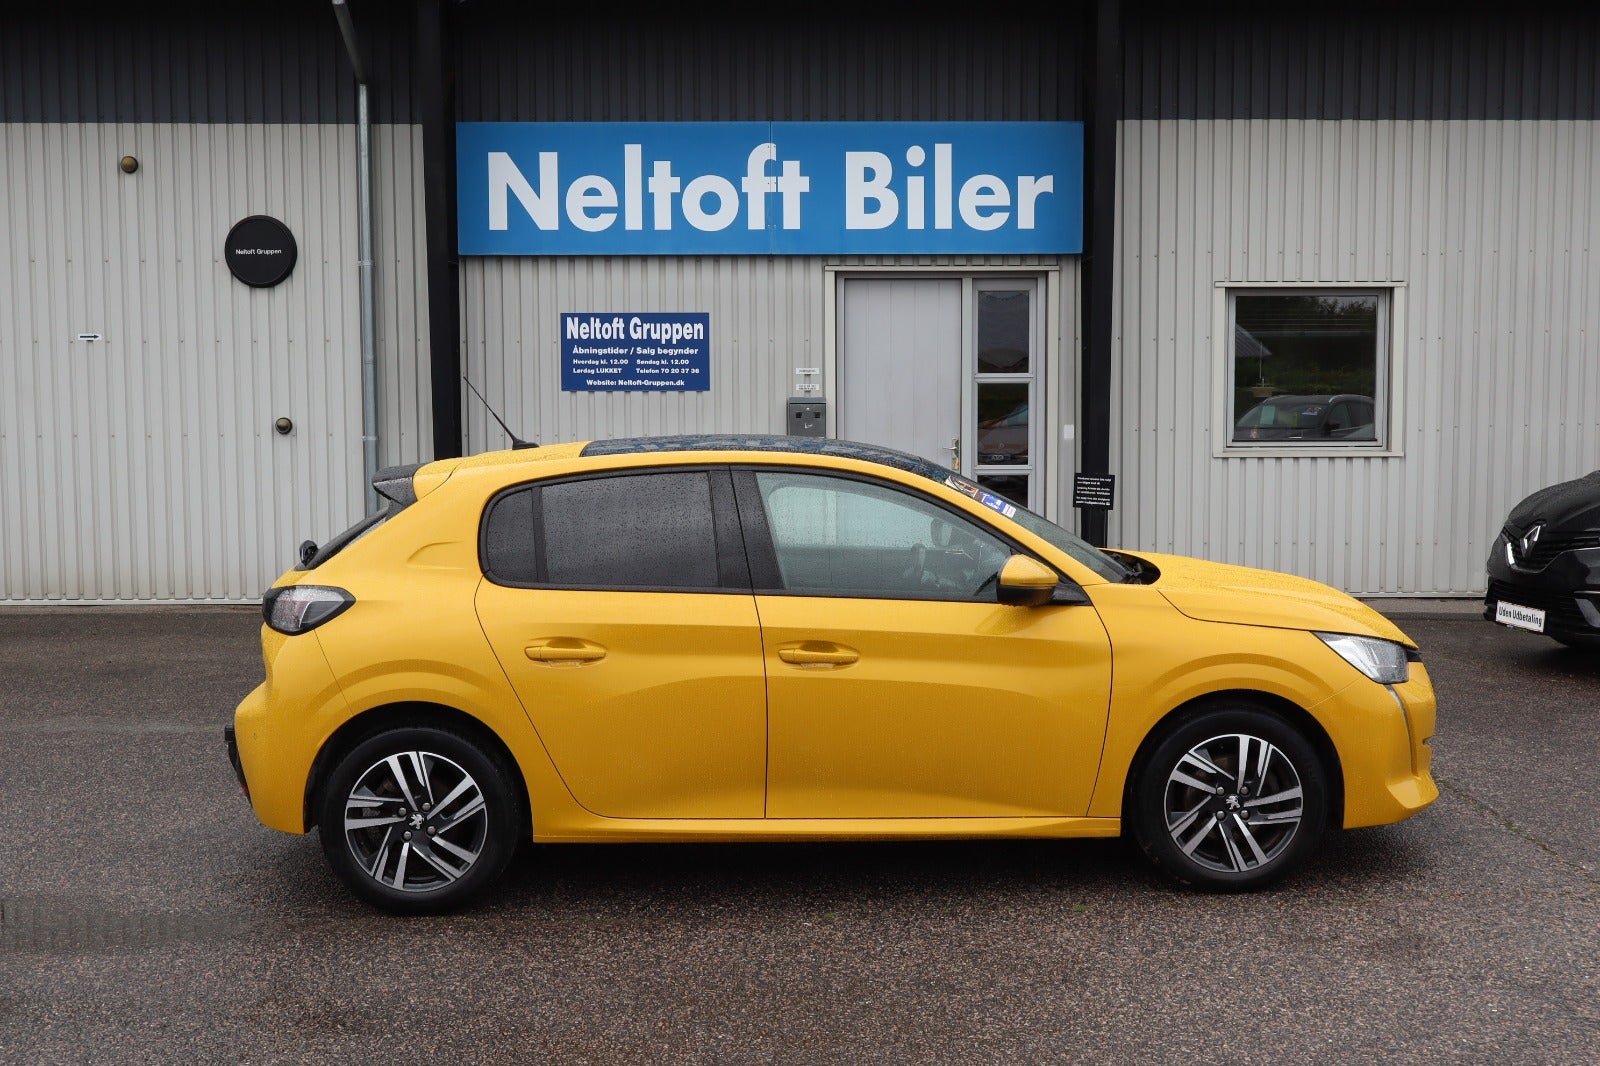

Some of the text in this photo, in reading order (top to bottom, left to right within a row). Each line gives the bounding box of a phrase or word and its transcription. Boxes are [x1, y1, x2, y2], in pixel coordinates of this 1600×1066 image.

[488, 143, 1053, 231] Neltoft Biler
[566, 316, 704, 344] Neltoft Gruppen
[572, 345, 628, 355] Åbningstider
[636, 347, 655, 355] Salg
[657, 347, 698, 355] begynder
[586, 379, 685, 387] Website: Neltoft-Gruppen.dk
[1498, 606, 1542, 627] Uden Udbetaling
